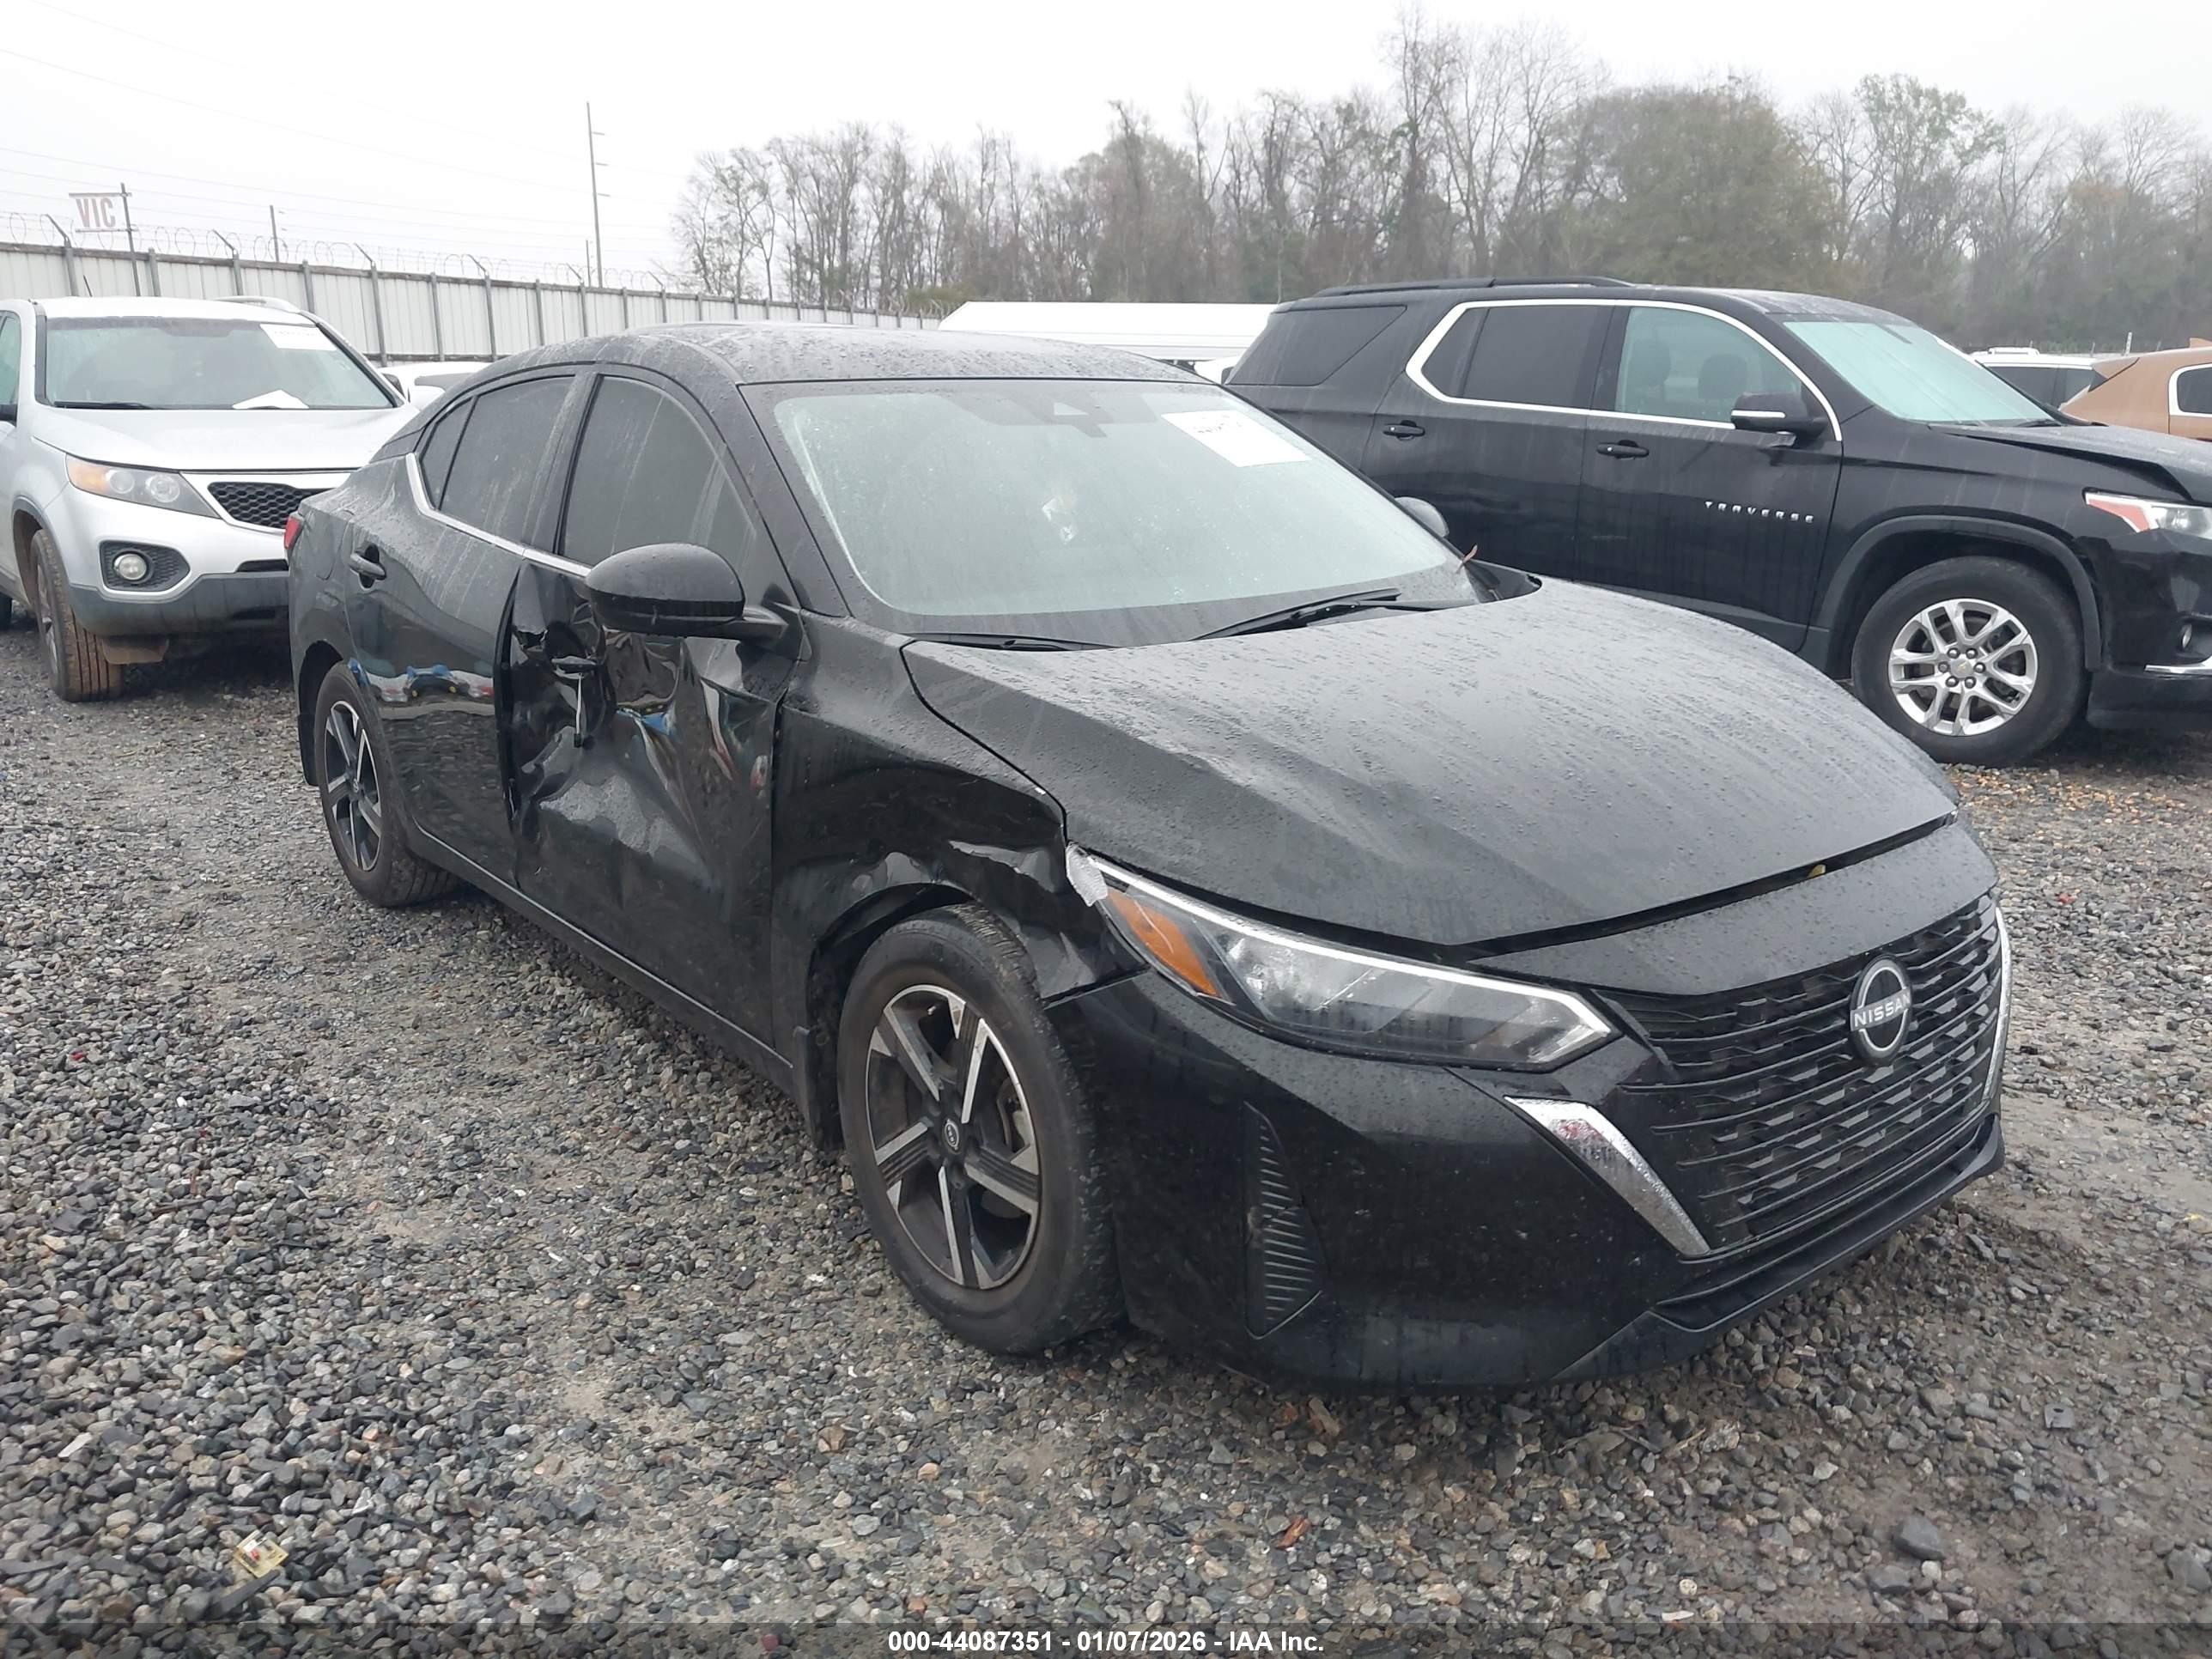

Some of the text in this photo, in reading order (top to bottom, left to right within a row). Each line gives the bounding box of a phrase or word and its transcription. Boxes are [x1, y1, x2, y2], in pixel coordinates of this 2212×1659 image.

[76, 198, 116, 228] VIC
[1705, 501, 1814, 523] TRAVERSE
[1854, 991, 1911, 1028] NISSAN
